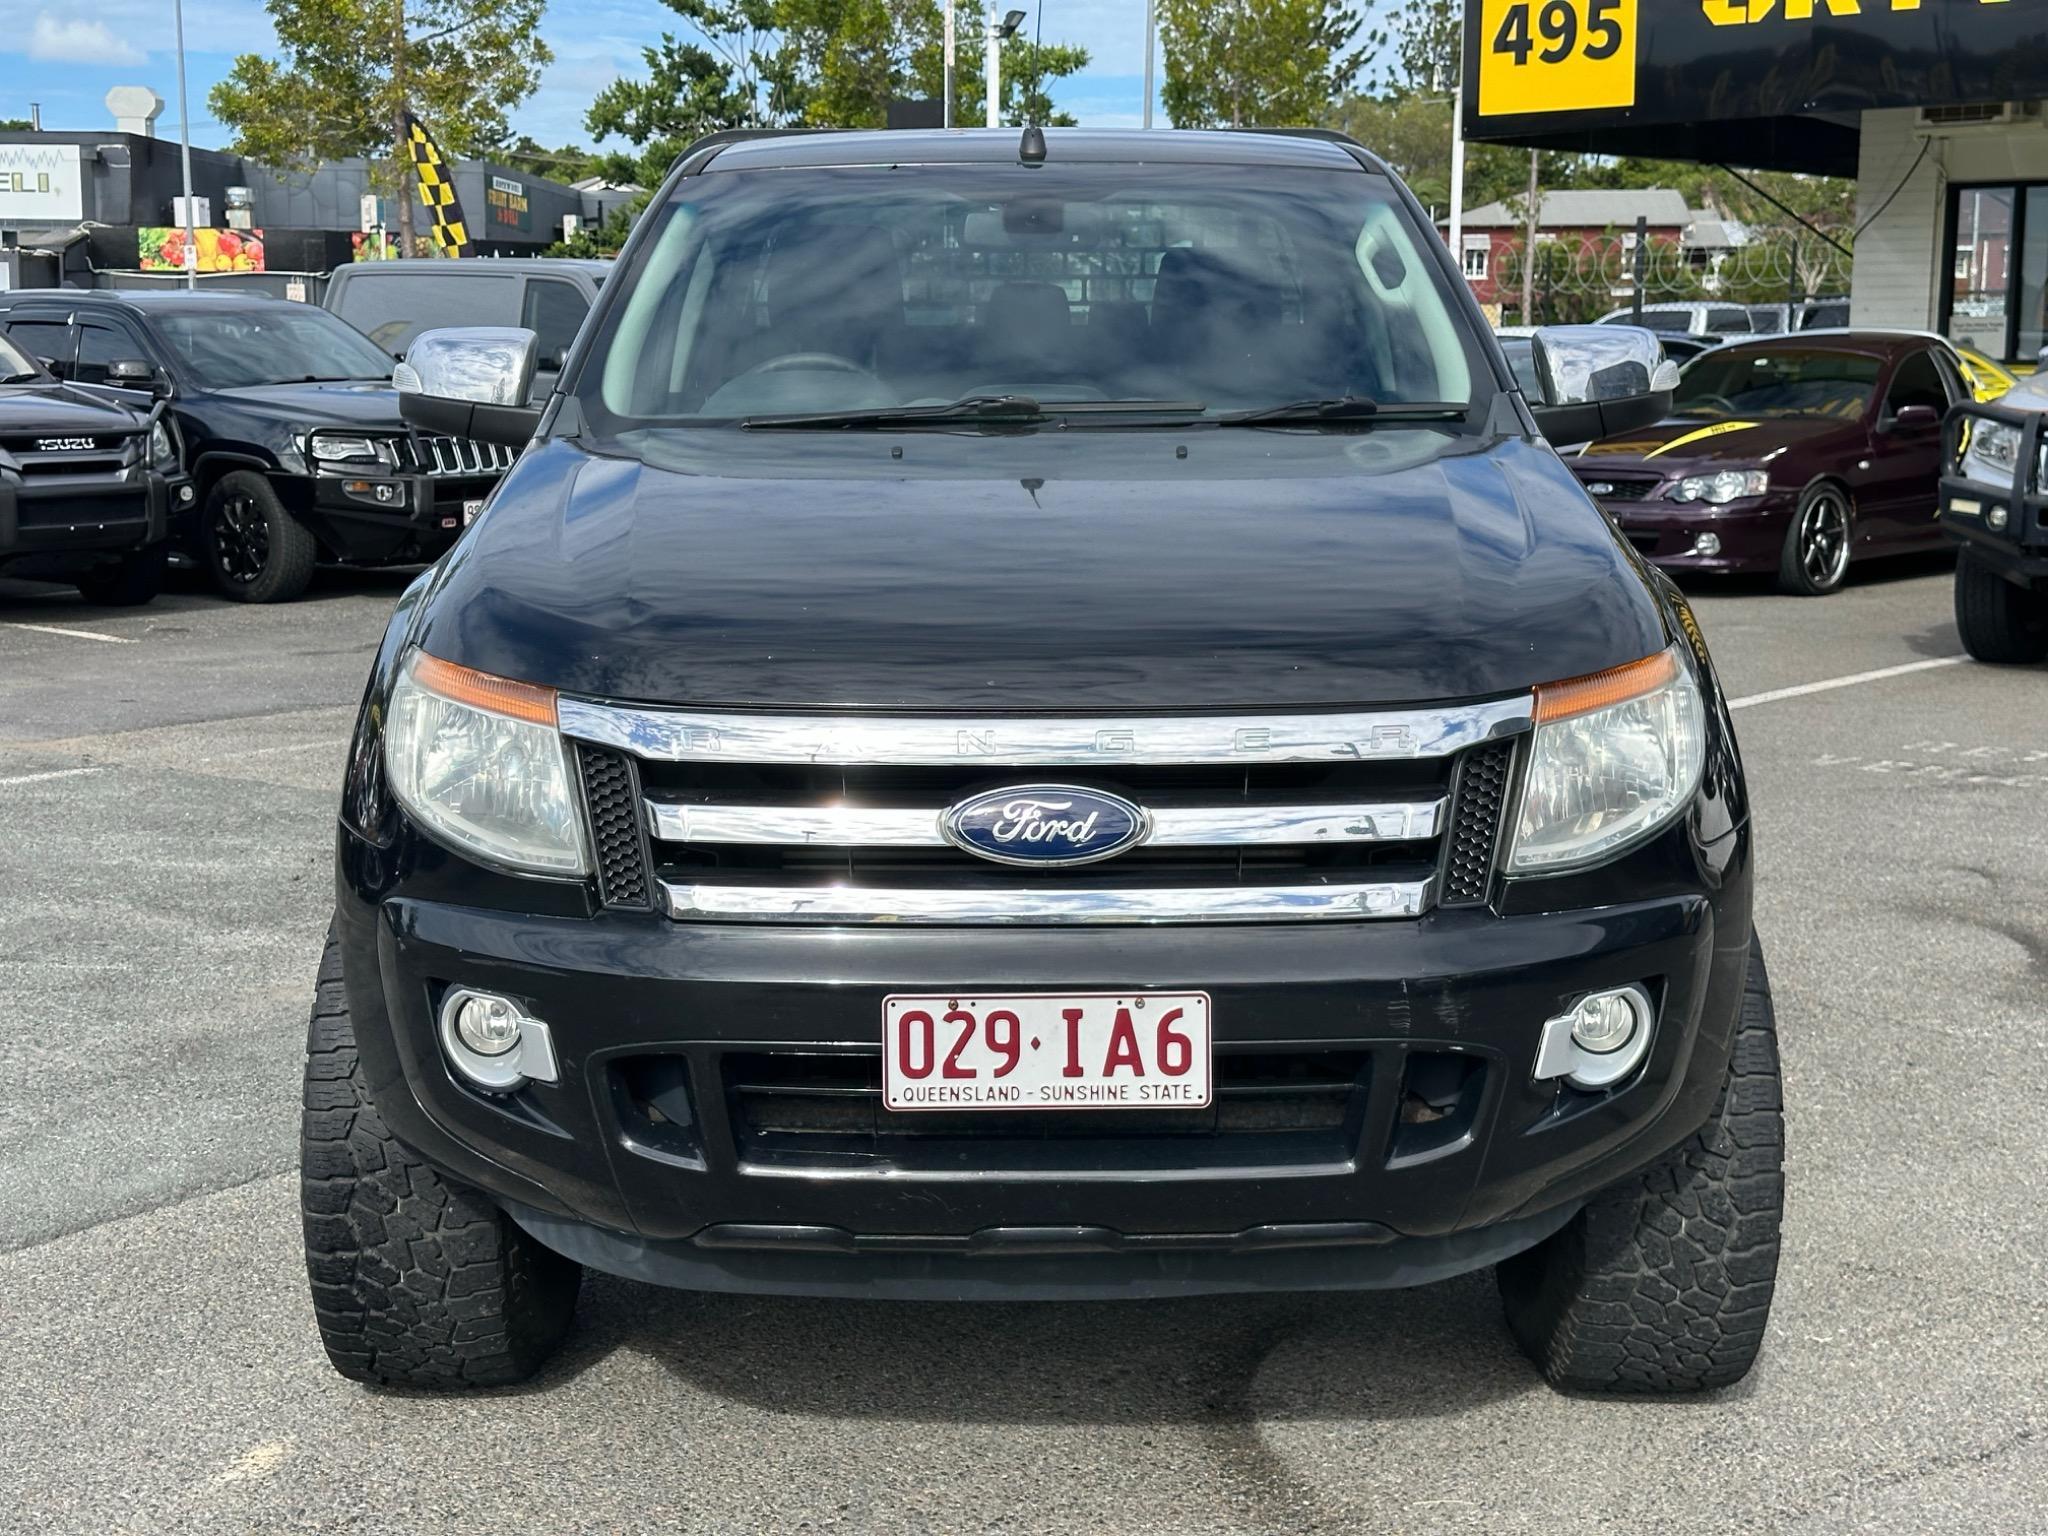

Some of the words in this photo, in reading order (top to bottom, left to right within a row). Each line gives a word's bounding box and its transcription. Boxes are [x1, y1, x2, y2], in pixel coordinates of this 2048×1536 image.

[1493, 0, 1623, 66] 495
[38, 437, 95, 451] ISUZU
[679, 724, 1411, 755] RNGER
[992, 800, 1099, 847] Ford
[903, 1086, 1020, 1102] QUEENSLAND
[1040, 1084, 1129, 1101] SUNSHINE
[1139, 1084, 1193, 1100] STATE
